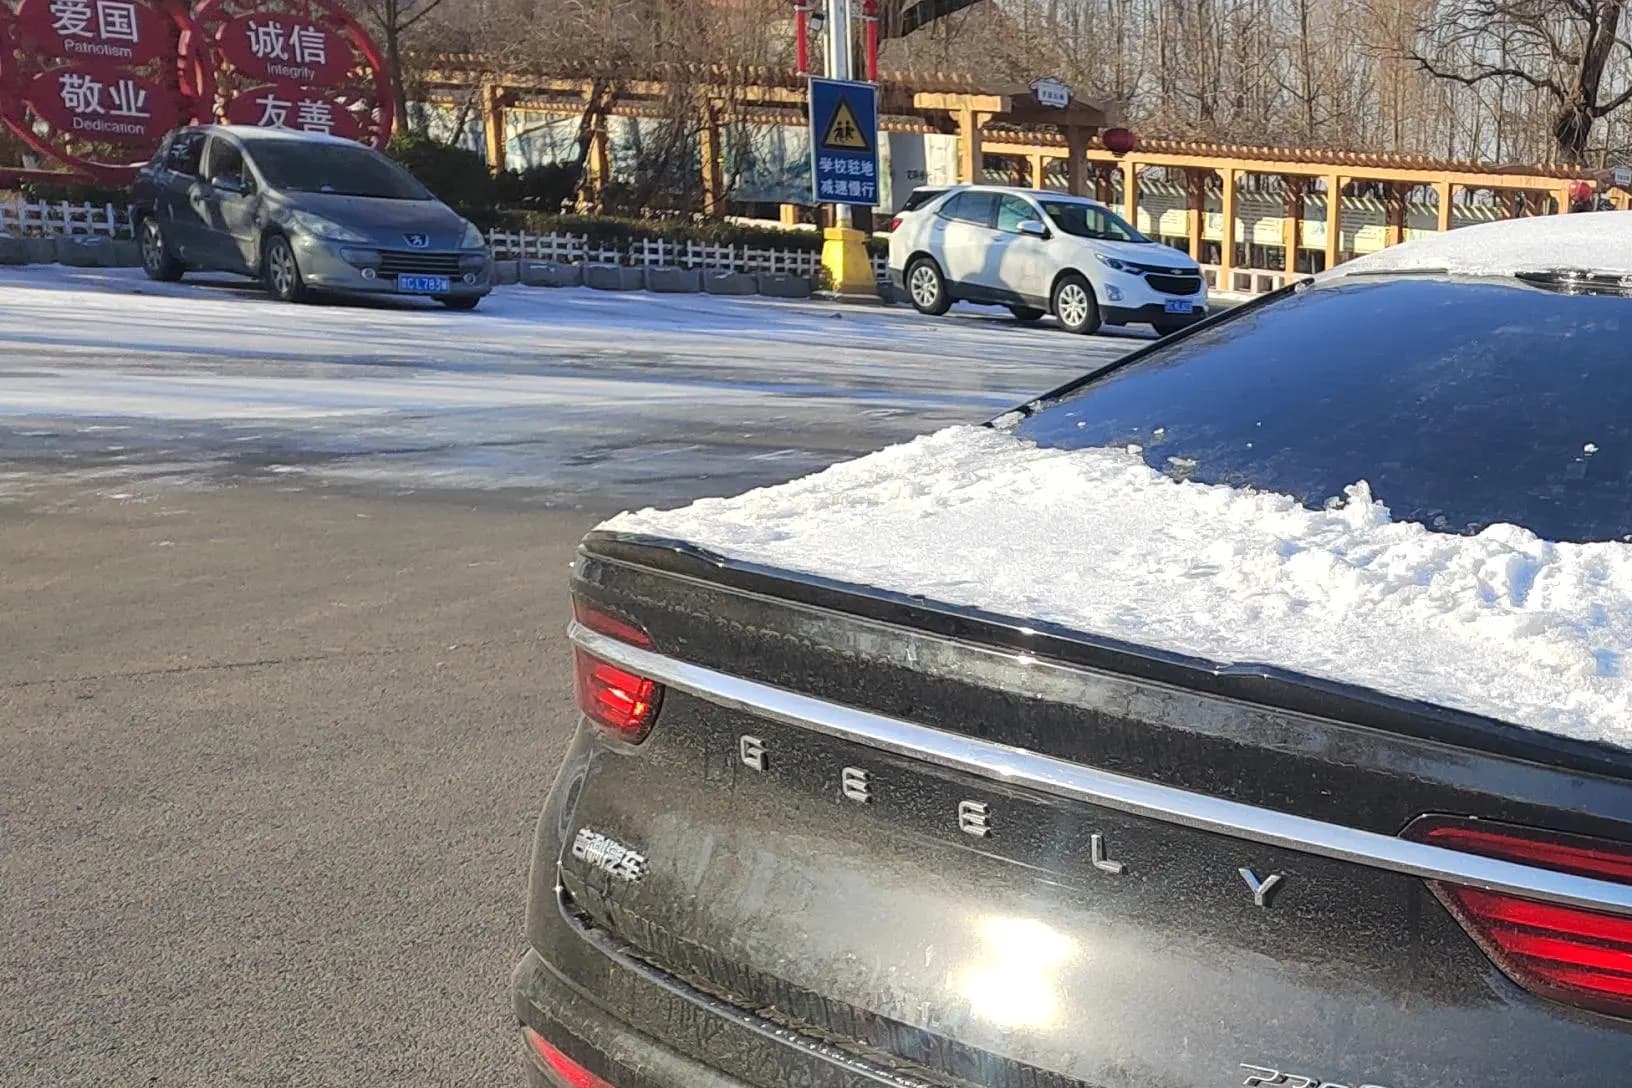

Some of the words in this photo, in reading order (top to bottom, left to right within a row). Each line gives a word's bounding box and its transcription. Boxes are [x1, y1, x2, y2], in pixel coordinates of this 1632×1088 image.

[51, 0, 139, 43] 爱国
[247, 21, 326, 64] 诚信
[64, 39, 132, 57] Patriotism
[267, 64, 315, 80] Integrity
[59, 74, 150, 118] 敬业
[255, 94, 335, 136] 友善
[73, 117, 144, 135] Dedication
[740, 734, 1282, 907] GEELY
